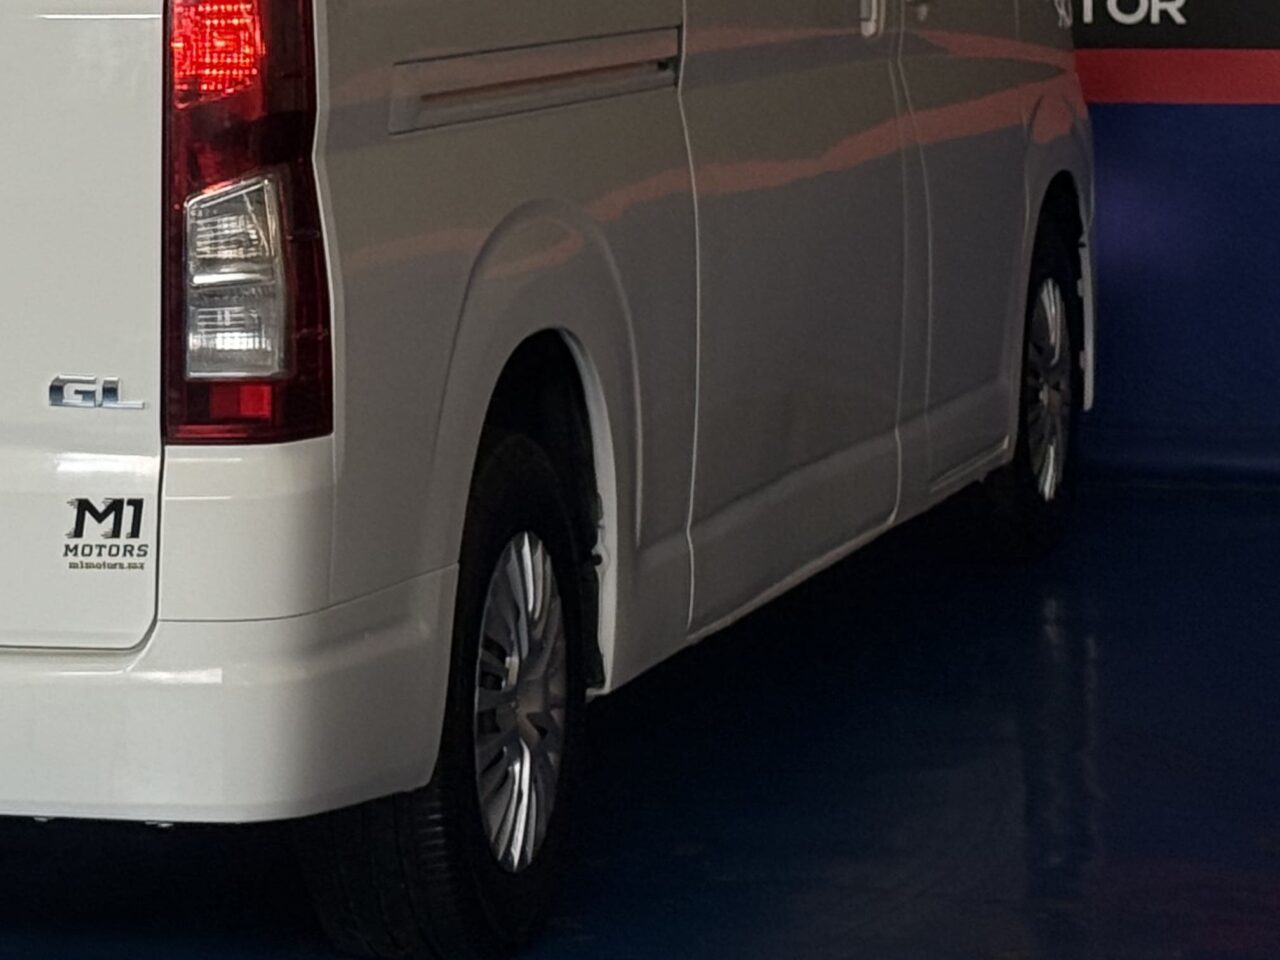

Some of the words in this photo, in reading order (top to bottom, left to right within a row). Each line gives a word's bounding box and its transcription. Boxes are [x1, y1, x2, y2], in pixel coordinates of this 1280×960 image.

[48, 375, 146, 409] GL
[65, 497, 144, 539] M1
[62, 543, 149, 558] MOTORS
